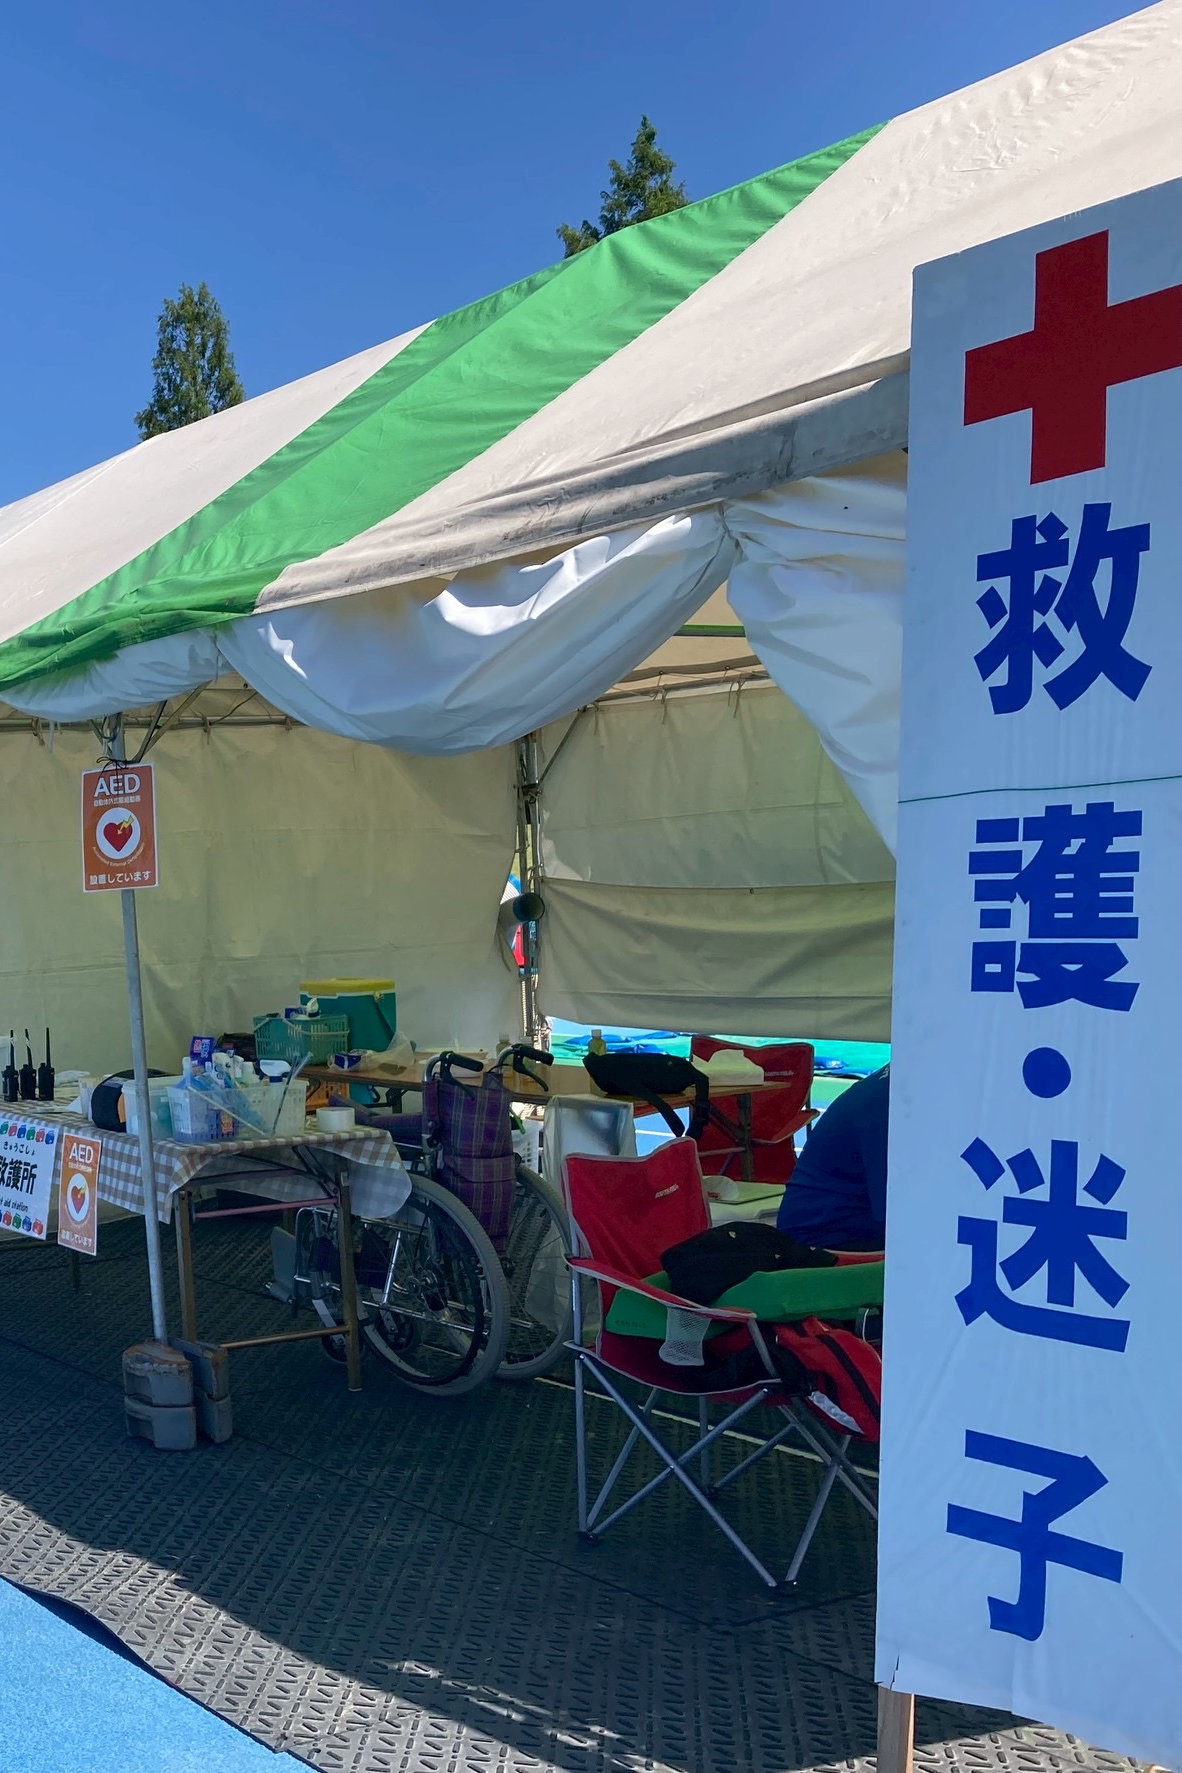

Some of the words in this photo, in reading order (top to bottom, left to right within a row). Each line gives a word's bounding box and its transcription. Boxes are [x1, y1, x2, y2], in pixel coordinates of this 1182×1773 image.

[94, 773, 141, 798] AED
[89, 870, 151, 886] 設置しています
[946, 501, 1153, 1641] 救護・迷子
[70, 1143, 93, 1163] AED
